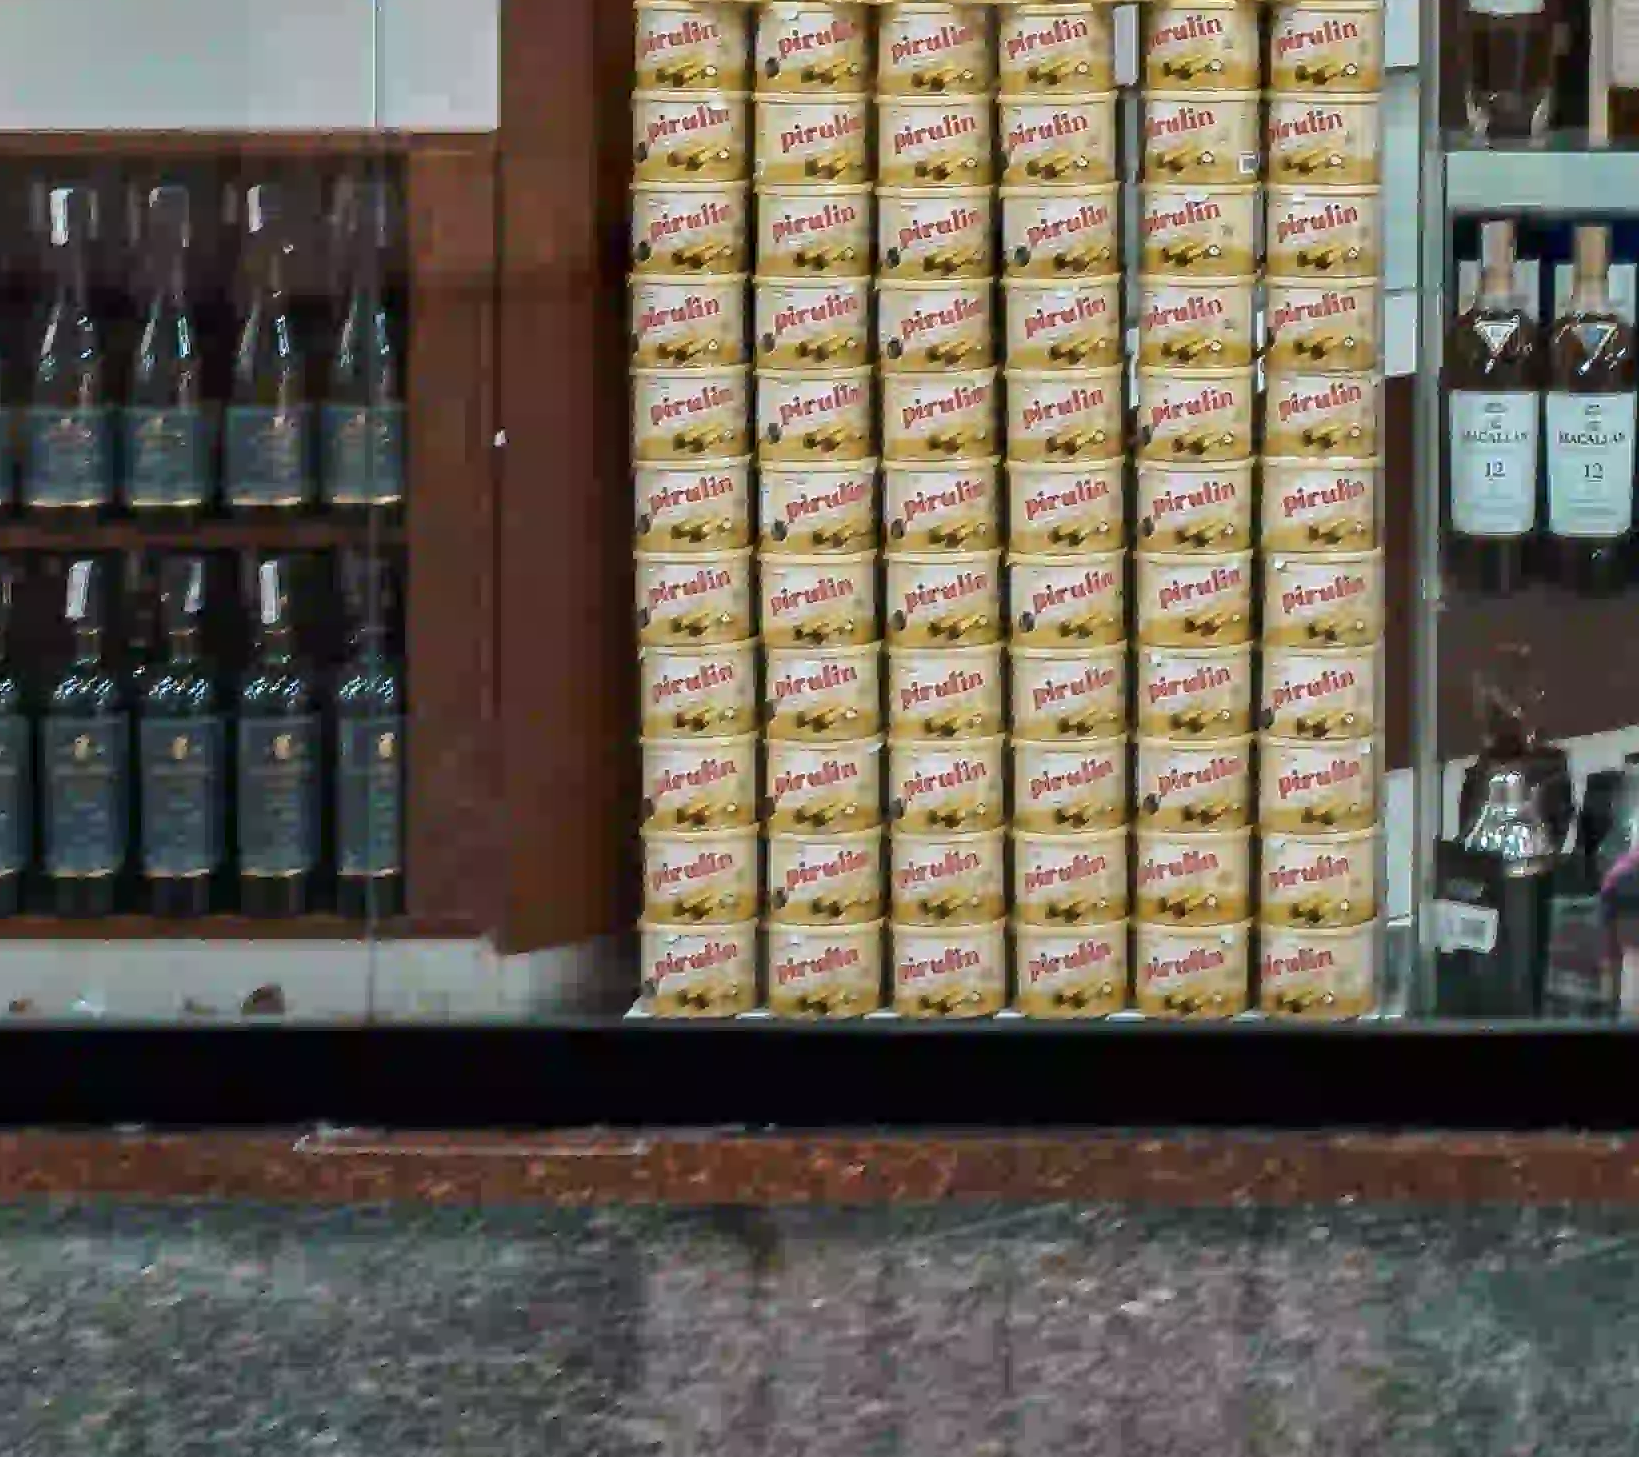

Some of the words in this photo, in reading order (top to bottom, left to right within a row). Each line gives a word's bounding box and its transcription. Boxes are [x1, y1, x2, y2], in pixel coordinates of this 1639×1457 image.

[1005, 18, 1088, 57] pirulin
[1275, 20, 1358, 57] pirulin
[645, 109, 730, 144] pirulin
[893, 115, 977, 151] pirulin
[1008, 113, 1088, 150] pirulin
[1146, 109, 1215, 141] irulin
[649, 205, 732, 243] pirulin
[771, 205, 856, 241] pirulin
[1027, 208, 1108, 244] pirulin
[1277, 205, 1358, 241] pirulin
[637, 298, 720, 335] pirulin
[773, 296, 858, 335] pirulin
[1024, 298, 1106, 337] pirulin
[1271, 293, 1356, 329] pirulin
[650, 388, 732, 423] pirulin
[1022, 389, 1105, 428] pirulin
[1151, 390, 1234, 428] pirulin
[1277, 384, 1361, 421] pirulin
[1485, 462, 1506, 478] 12
[1584, 463, 1603, 479] 12
[650, 477, 733, 516] pirulin
[1024, 480, 1108, 519] pirulin
[1152, 484, 1235, 519] pirulin
[1283, 479, 1364, 518] pirulin
[647, 570, 731, 605] pirulin
[769, 579, 854, 616] pirulin
[903, 574, 987, 612] pirulin
[1032, 572, 1117, 611] pirulin
[1159, 569, 1242, 606] pirulin
[1282, 576, 1364, 612] pirulin
[651, 665, 733, 702] pirulin
[774, 665, 857, 700] pirulin
[900, 674, 984, 710] pirulin
[1032, 672, 1115, 709] pirulin
[1147, 667, 1229, 702] pirulin
[1271, 669, 1354, 707] pirulin
[903, 764, 987, 801] pirulin
[1278, 760, 1361, 797] pirulin
[654, 941, 737, 980] pirulin
